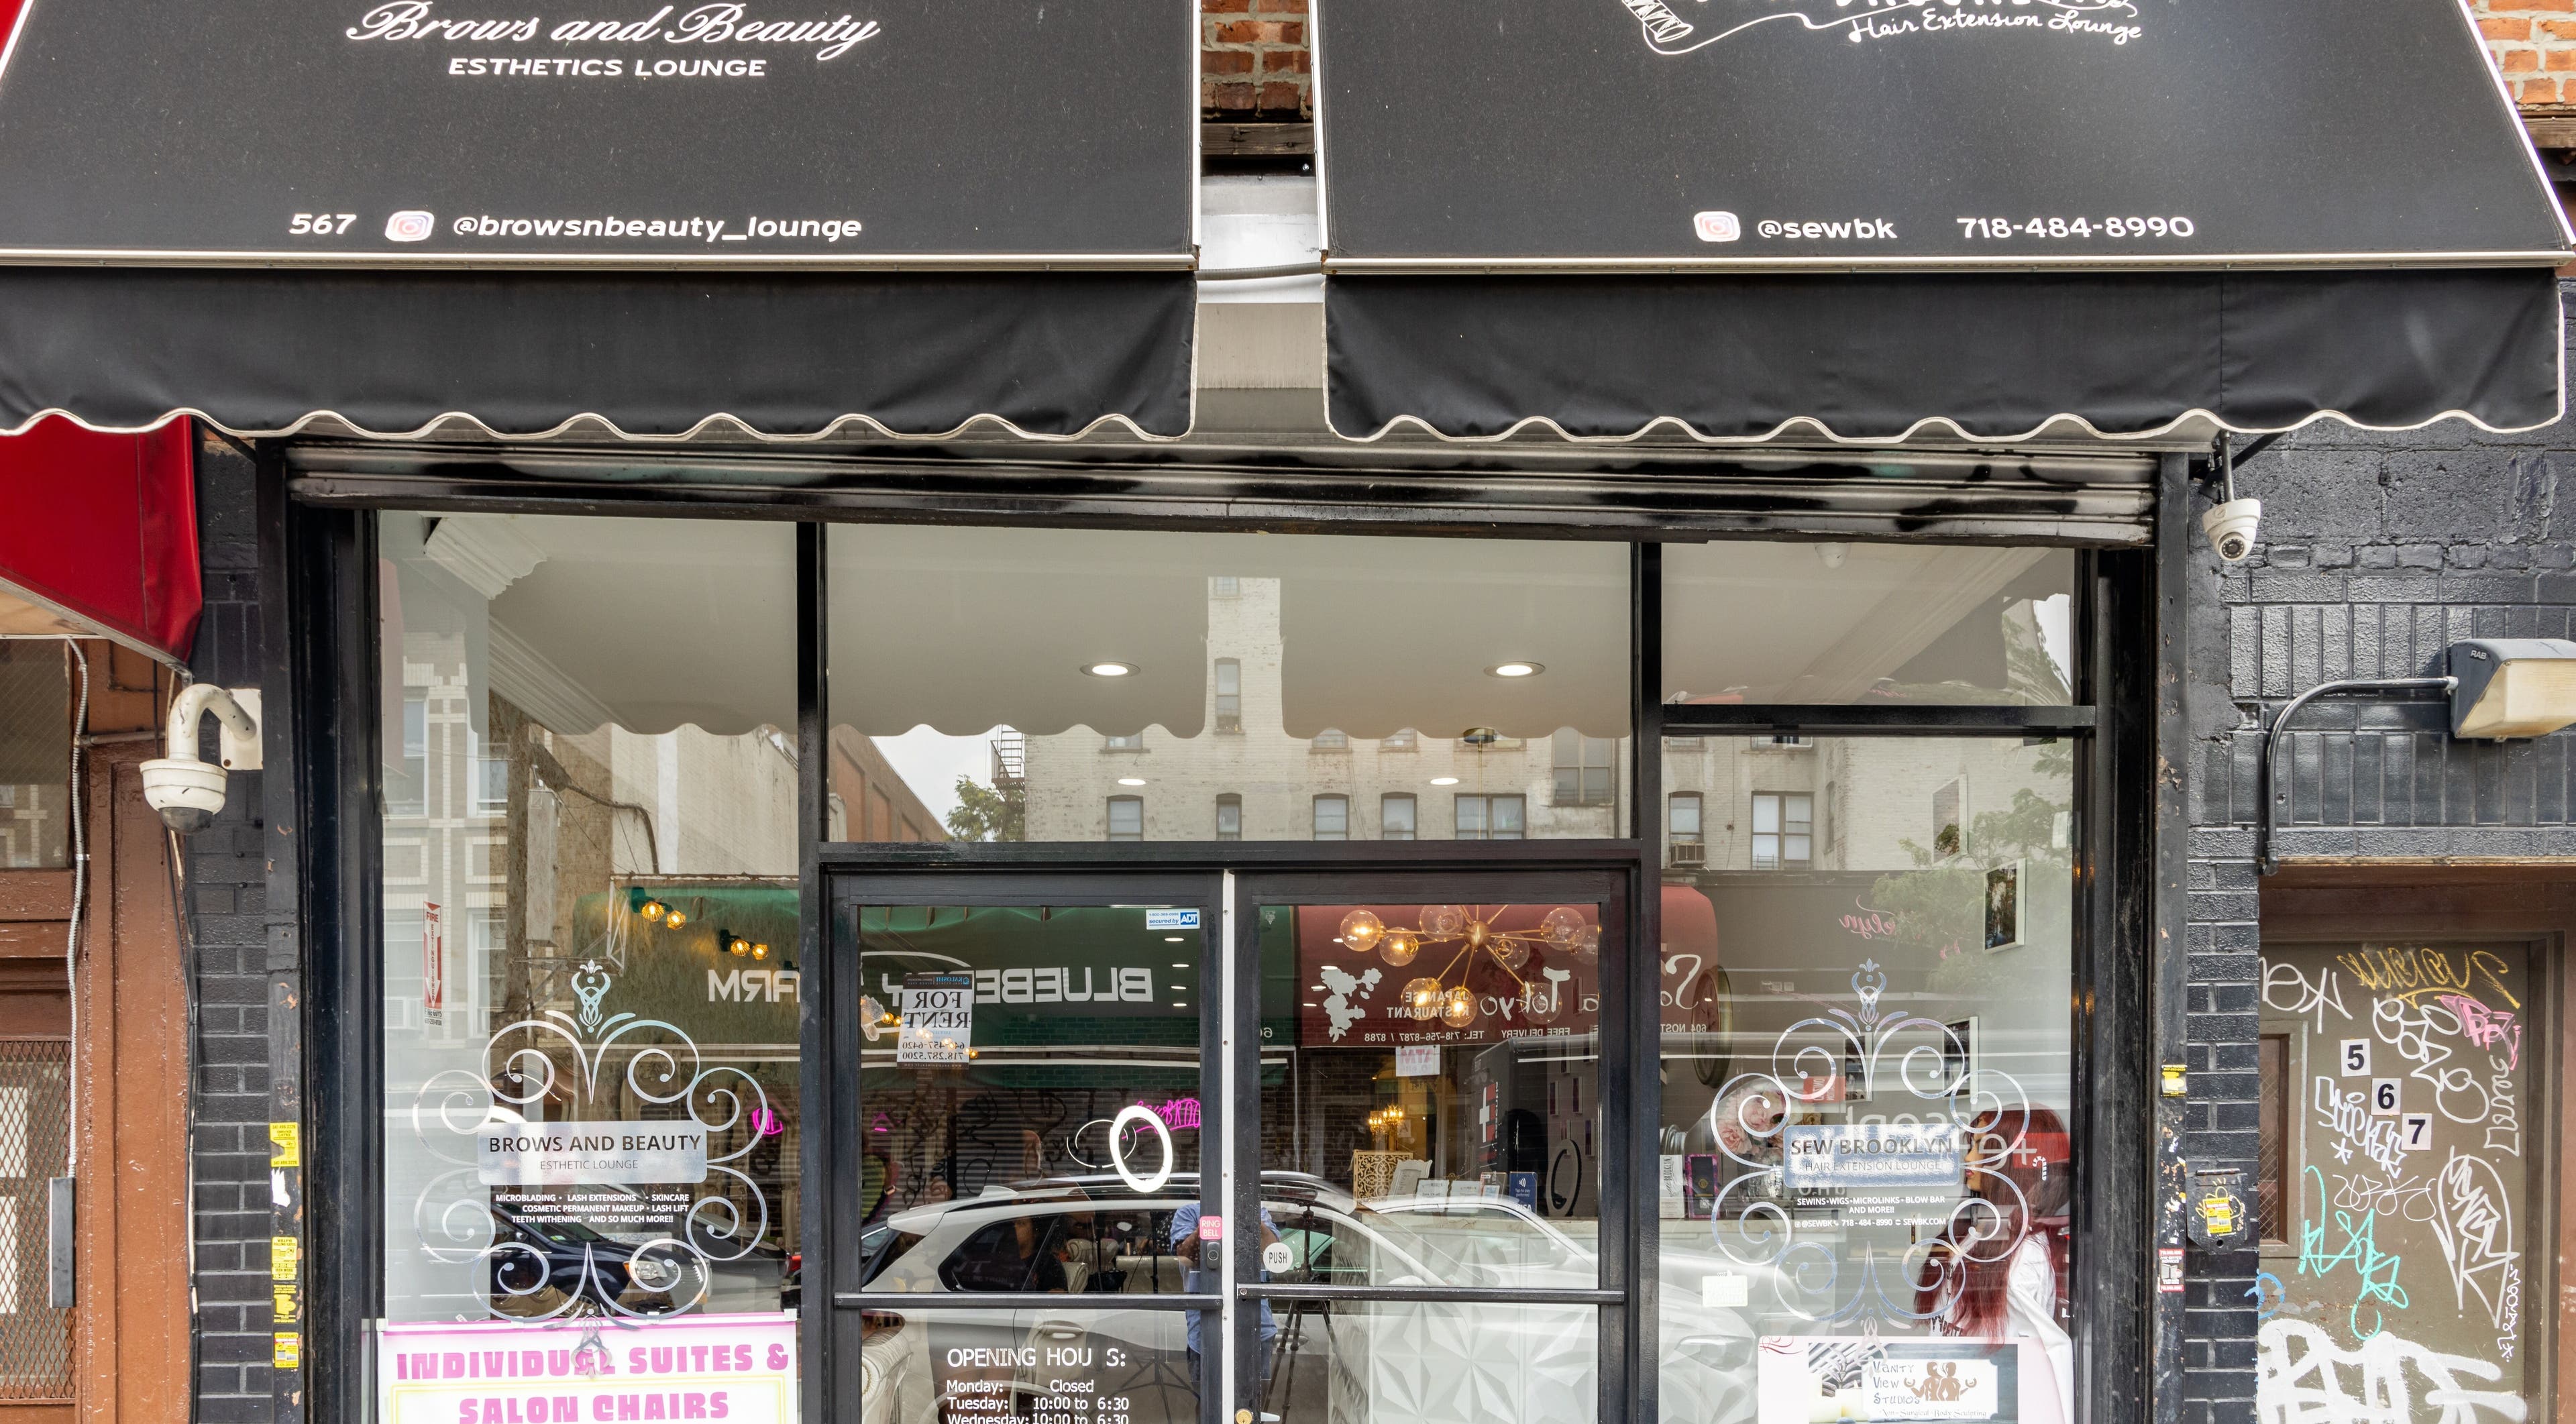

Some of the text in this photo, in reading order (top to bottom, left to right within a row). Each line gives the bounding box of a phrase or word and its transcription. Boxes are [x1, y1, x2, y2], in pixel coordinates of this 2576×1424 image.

[345, 0, 881, 61] Brows and Beauty
[1848, 8, 2143, 46] Hair Extension Lounge
[448, 58, 767, 78] ESTHETICS LOUNGE
[288, 213, 357, 235] 567
[452, 215, 863, 242] @browsnbeauty_lounge
[1757, 217, 1898, 240] @sewbk
[1956, 216, 2195, 239] 718-484-8990
[2470, 650, 2487, 660] RAB
[426, 912, 439, 923] FIRE
[1181, 914, 1197, 923] ADT
[2347, 1044, 2365, 1071] 5
[2377, 1083, 2395, 1110] 6
[2408, 1119, 2426, 1144] 7
[488, 1134, 702, 1153] BROWS AND BEAUTY
[1790, 1140, 1833, 1156] SEW
[1839, 1138, 1952, 1155] BROOKLYN
[539, 1160, 639, 1170] ESTHETIC LOUNGE
[1805, 1160, 1941, 1172] HAIR EXTENSION LOUNGE
[1796, 1197, 1827, 1205] SEWINS
[1829, 1197, 1849, 1205] WIGS
[1853, 1196, 1900, 1205] MICROLINKS
[1905, 1196, 1927, 1204] BLOW
[1848, 1206, 1866, 1214] AND
[537, 1215, 582, 1223] WITHENING
[1201, 1219, 1222, 1229] RING
[1801, 1219, 1833, 1227] @SEWBK
[1903, 1218, 1946, 1226] SEWBK.COM
[1202, 1229, 1220, 1238] BELL
[1268, 1252, 1288, 1264] PUSH
[396, 1343, 790, 1380] INDIVIDUAL SUITES &
[947, 1348, 1126, 1368] OPENING HOUS:
[947, 1379, 1094, 1396] Monday: Closed
[460, 1391, 730, 1424] SALON CHAIRS
[947, 1396, 1130, 1413] Tuesday: 10:00 to 6:30
[947, 1413, 1130, 1424] Wednesday: 10:00 to 6:30
